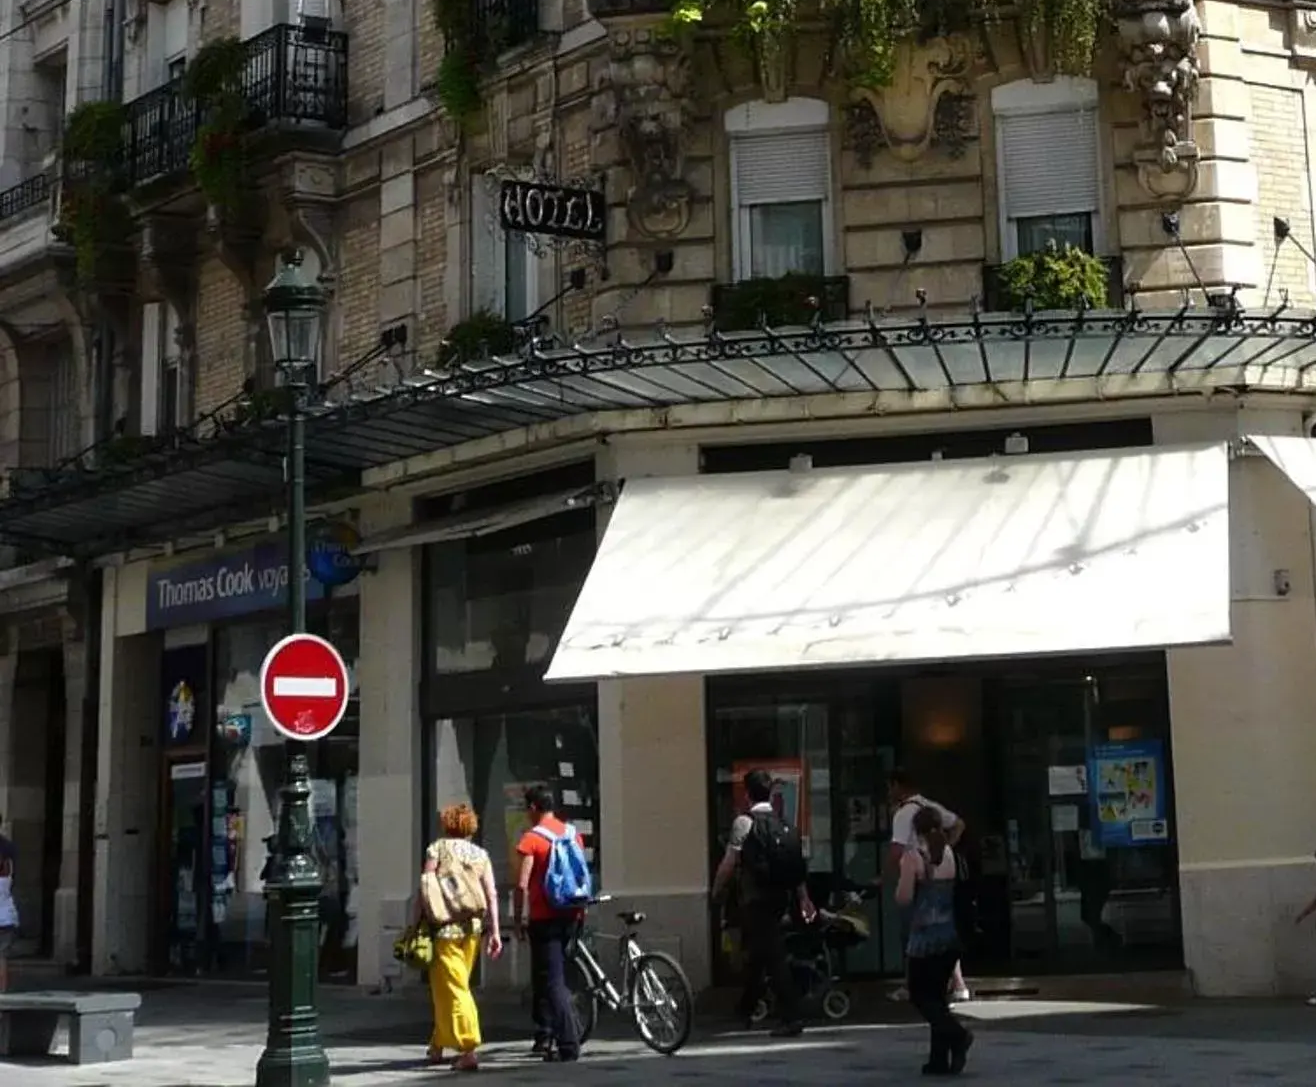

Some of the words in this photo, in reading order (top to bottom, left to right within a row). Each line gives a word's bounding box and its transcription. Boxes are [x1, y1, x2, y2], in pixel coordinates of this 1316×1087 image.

[503, 185, 603, 232] HOTEL
[157, 575, 215, 609] Thomas
[217, 562, 254, 598] Cook
